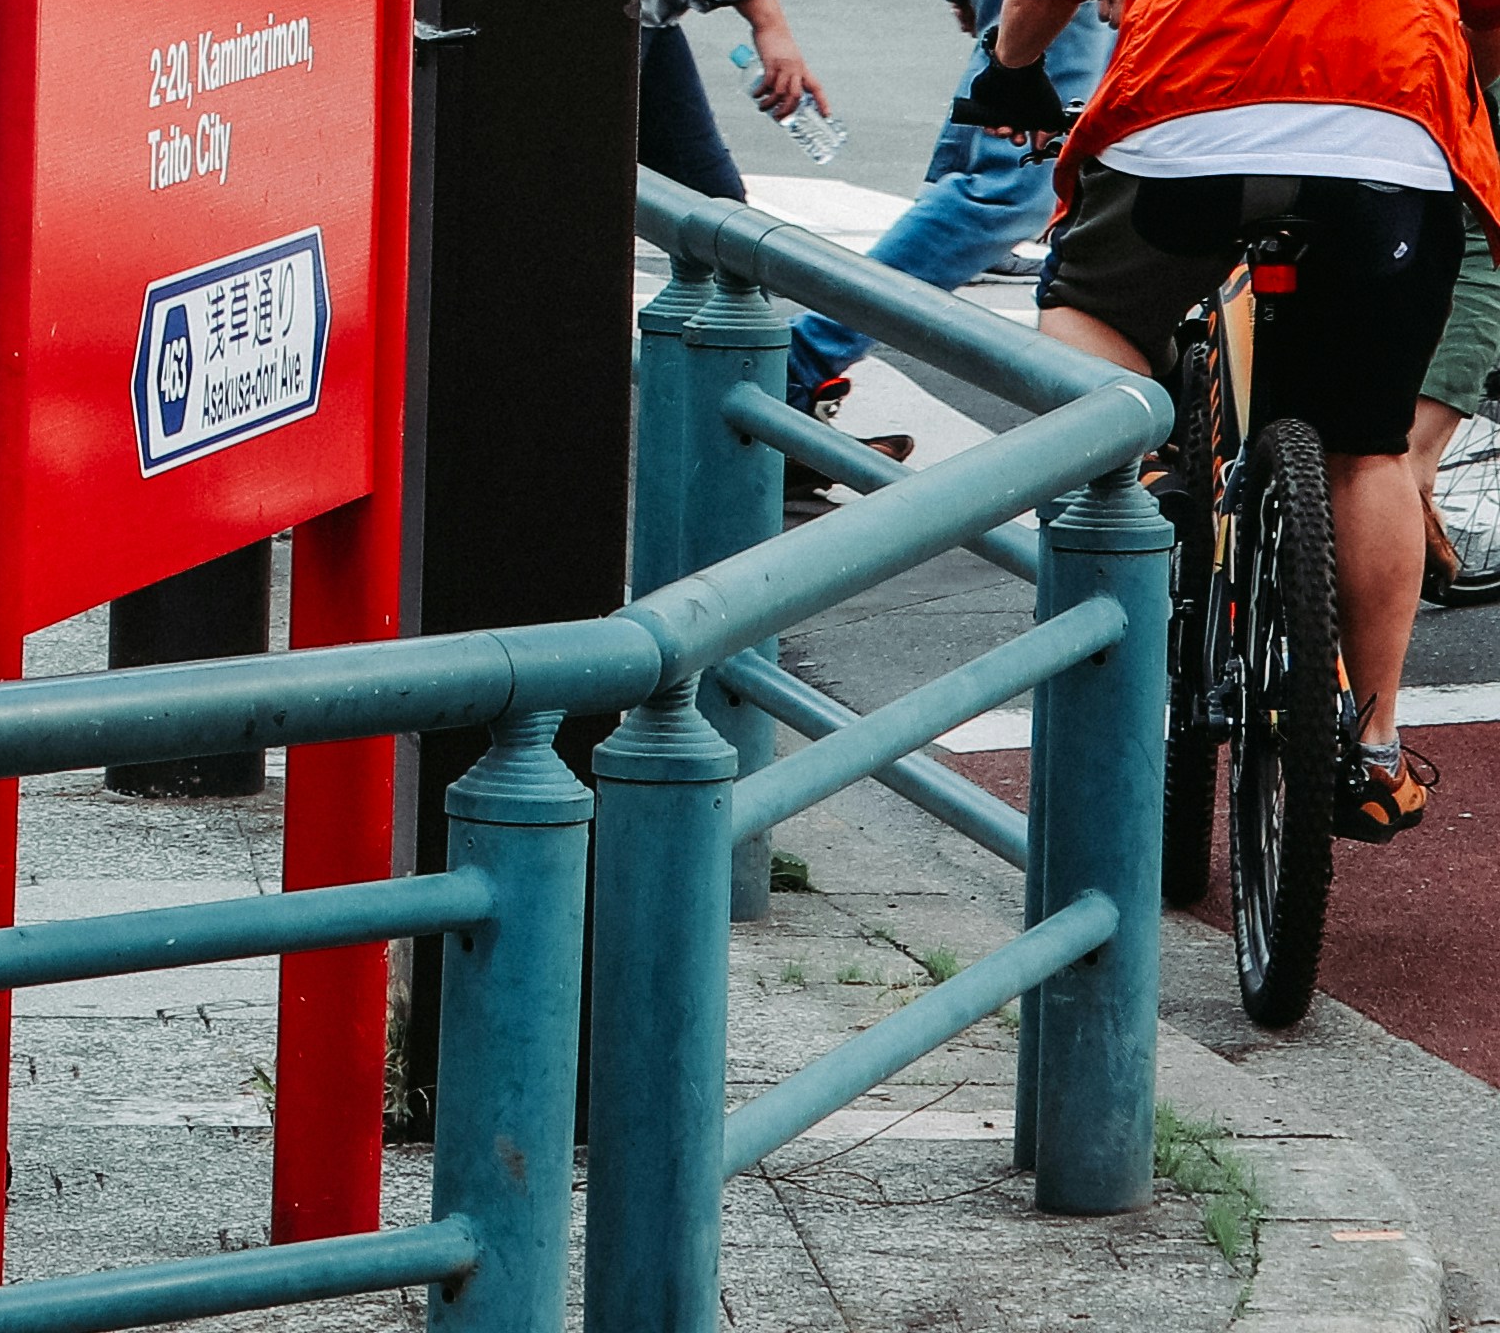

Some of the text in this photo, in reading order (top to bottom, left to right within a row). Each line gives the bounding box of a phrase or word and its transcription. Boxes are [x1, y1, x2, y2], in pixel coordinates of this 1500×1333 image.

[148, 12, 314, 109] 2-20, Kaminarimon,
[147, 111, 232, 191] Taito City
[204, 261, 296, 365] 浅草通り
[159, 336, 188, 404] 463
[201, 351, 306, 431] Asakusa-dori Ave.
